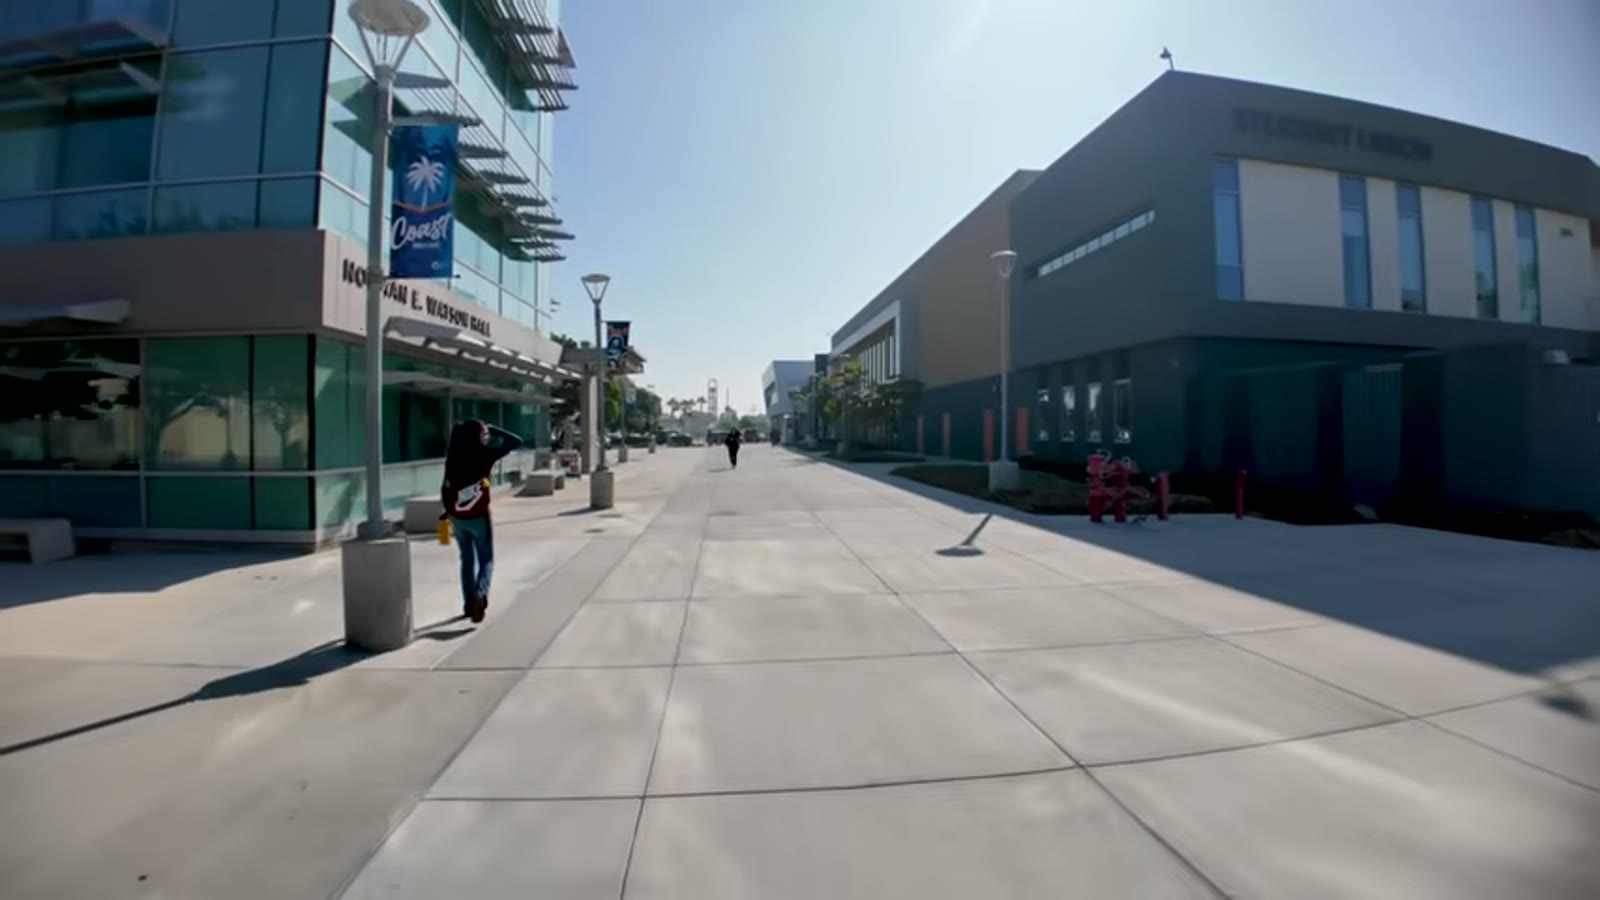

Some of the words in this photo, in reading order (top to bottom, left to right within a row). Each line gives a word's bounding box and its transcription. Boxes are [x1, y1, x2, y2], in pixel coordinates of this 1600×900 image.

[391, 213, 451, 249] Coast
[411, 290, 423, 310] E.
[426, 296, 469, 328] WATSON
[470, 316, 490, 337] HALL
